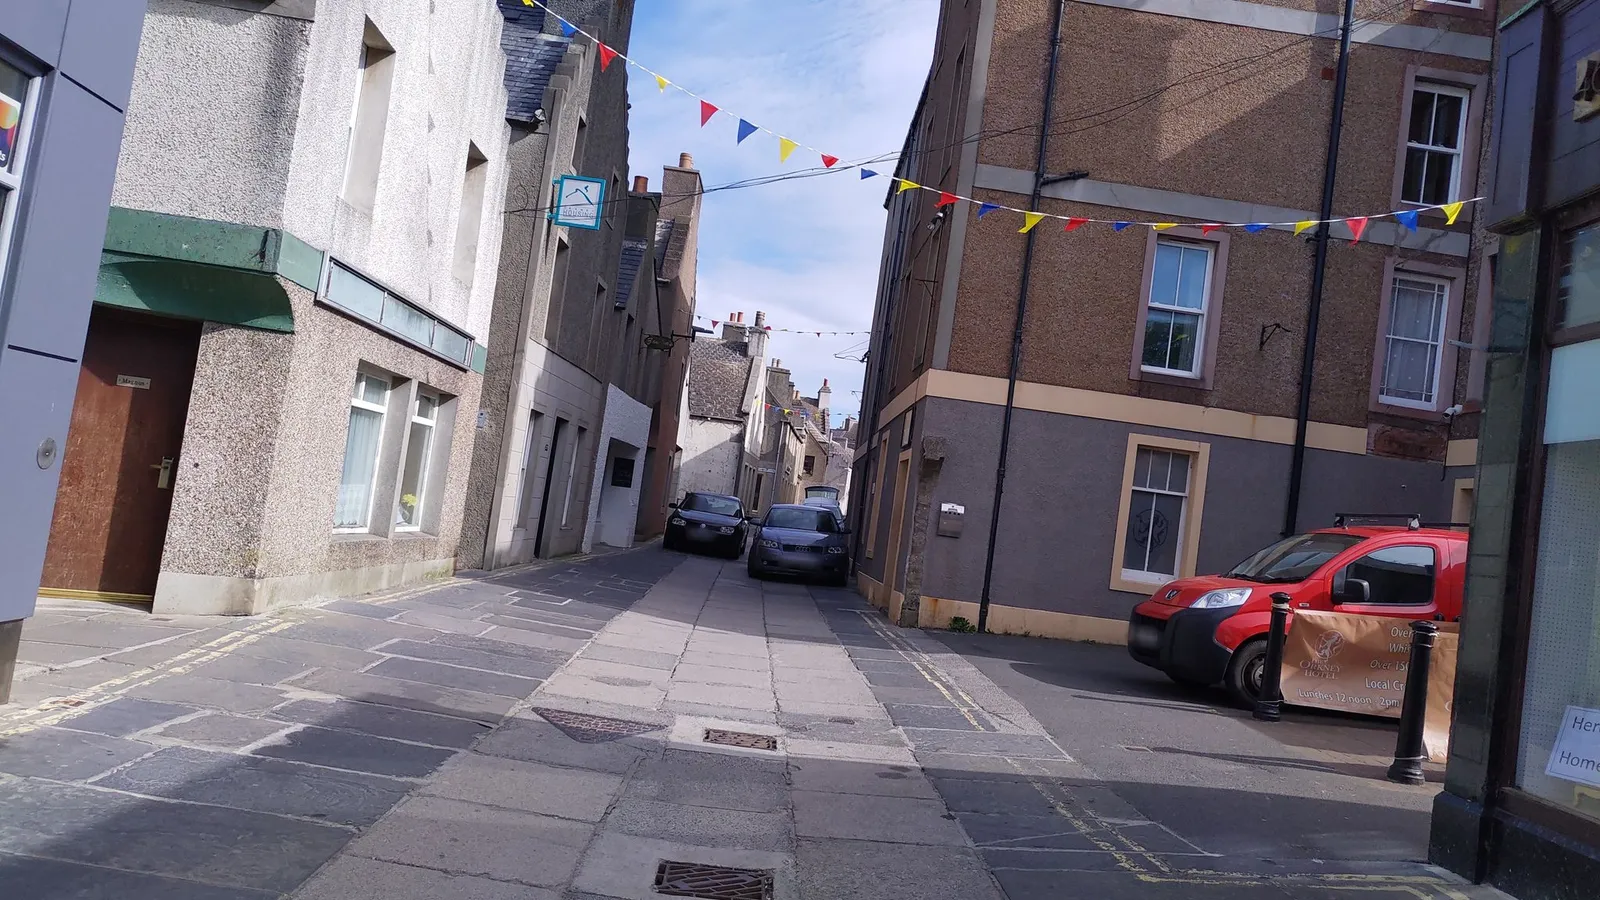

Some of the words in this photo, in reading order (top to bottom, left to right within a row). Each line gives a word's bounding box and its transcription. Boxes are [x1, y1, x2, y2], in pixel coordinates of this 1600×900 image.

[1391, 626, 1412, 639] Over
[1299, 659, 1342, 673] ORKNEY
[1370, 659, 1391, 669] Over
[1304, 669, 1338, 679] HOTEL
[1365, 677, 1390, 690] Local
[1393, 680, 1407, 691] Cr
[1299, 688, 1333, 701] Lunches
[1335, 692, 1346, 702] 12
[1348, 695, 1372, 704] noon
[1380, 696, 1400, 709] 2pm
[1572, 716, 1600, 733] Her
